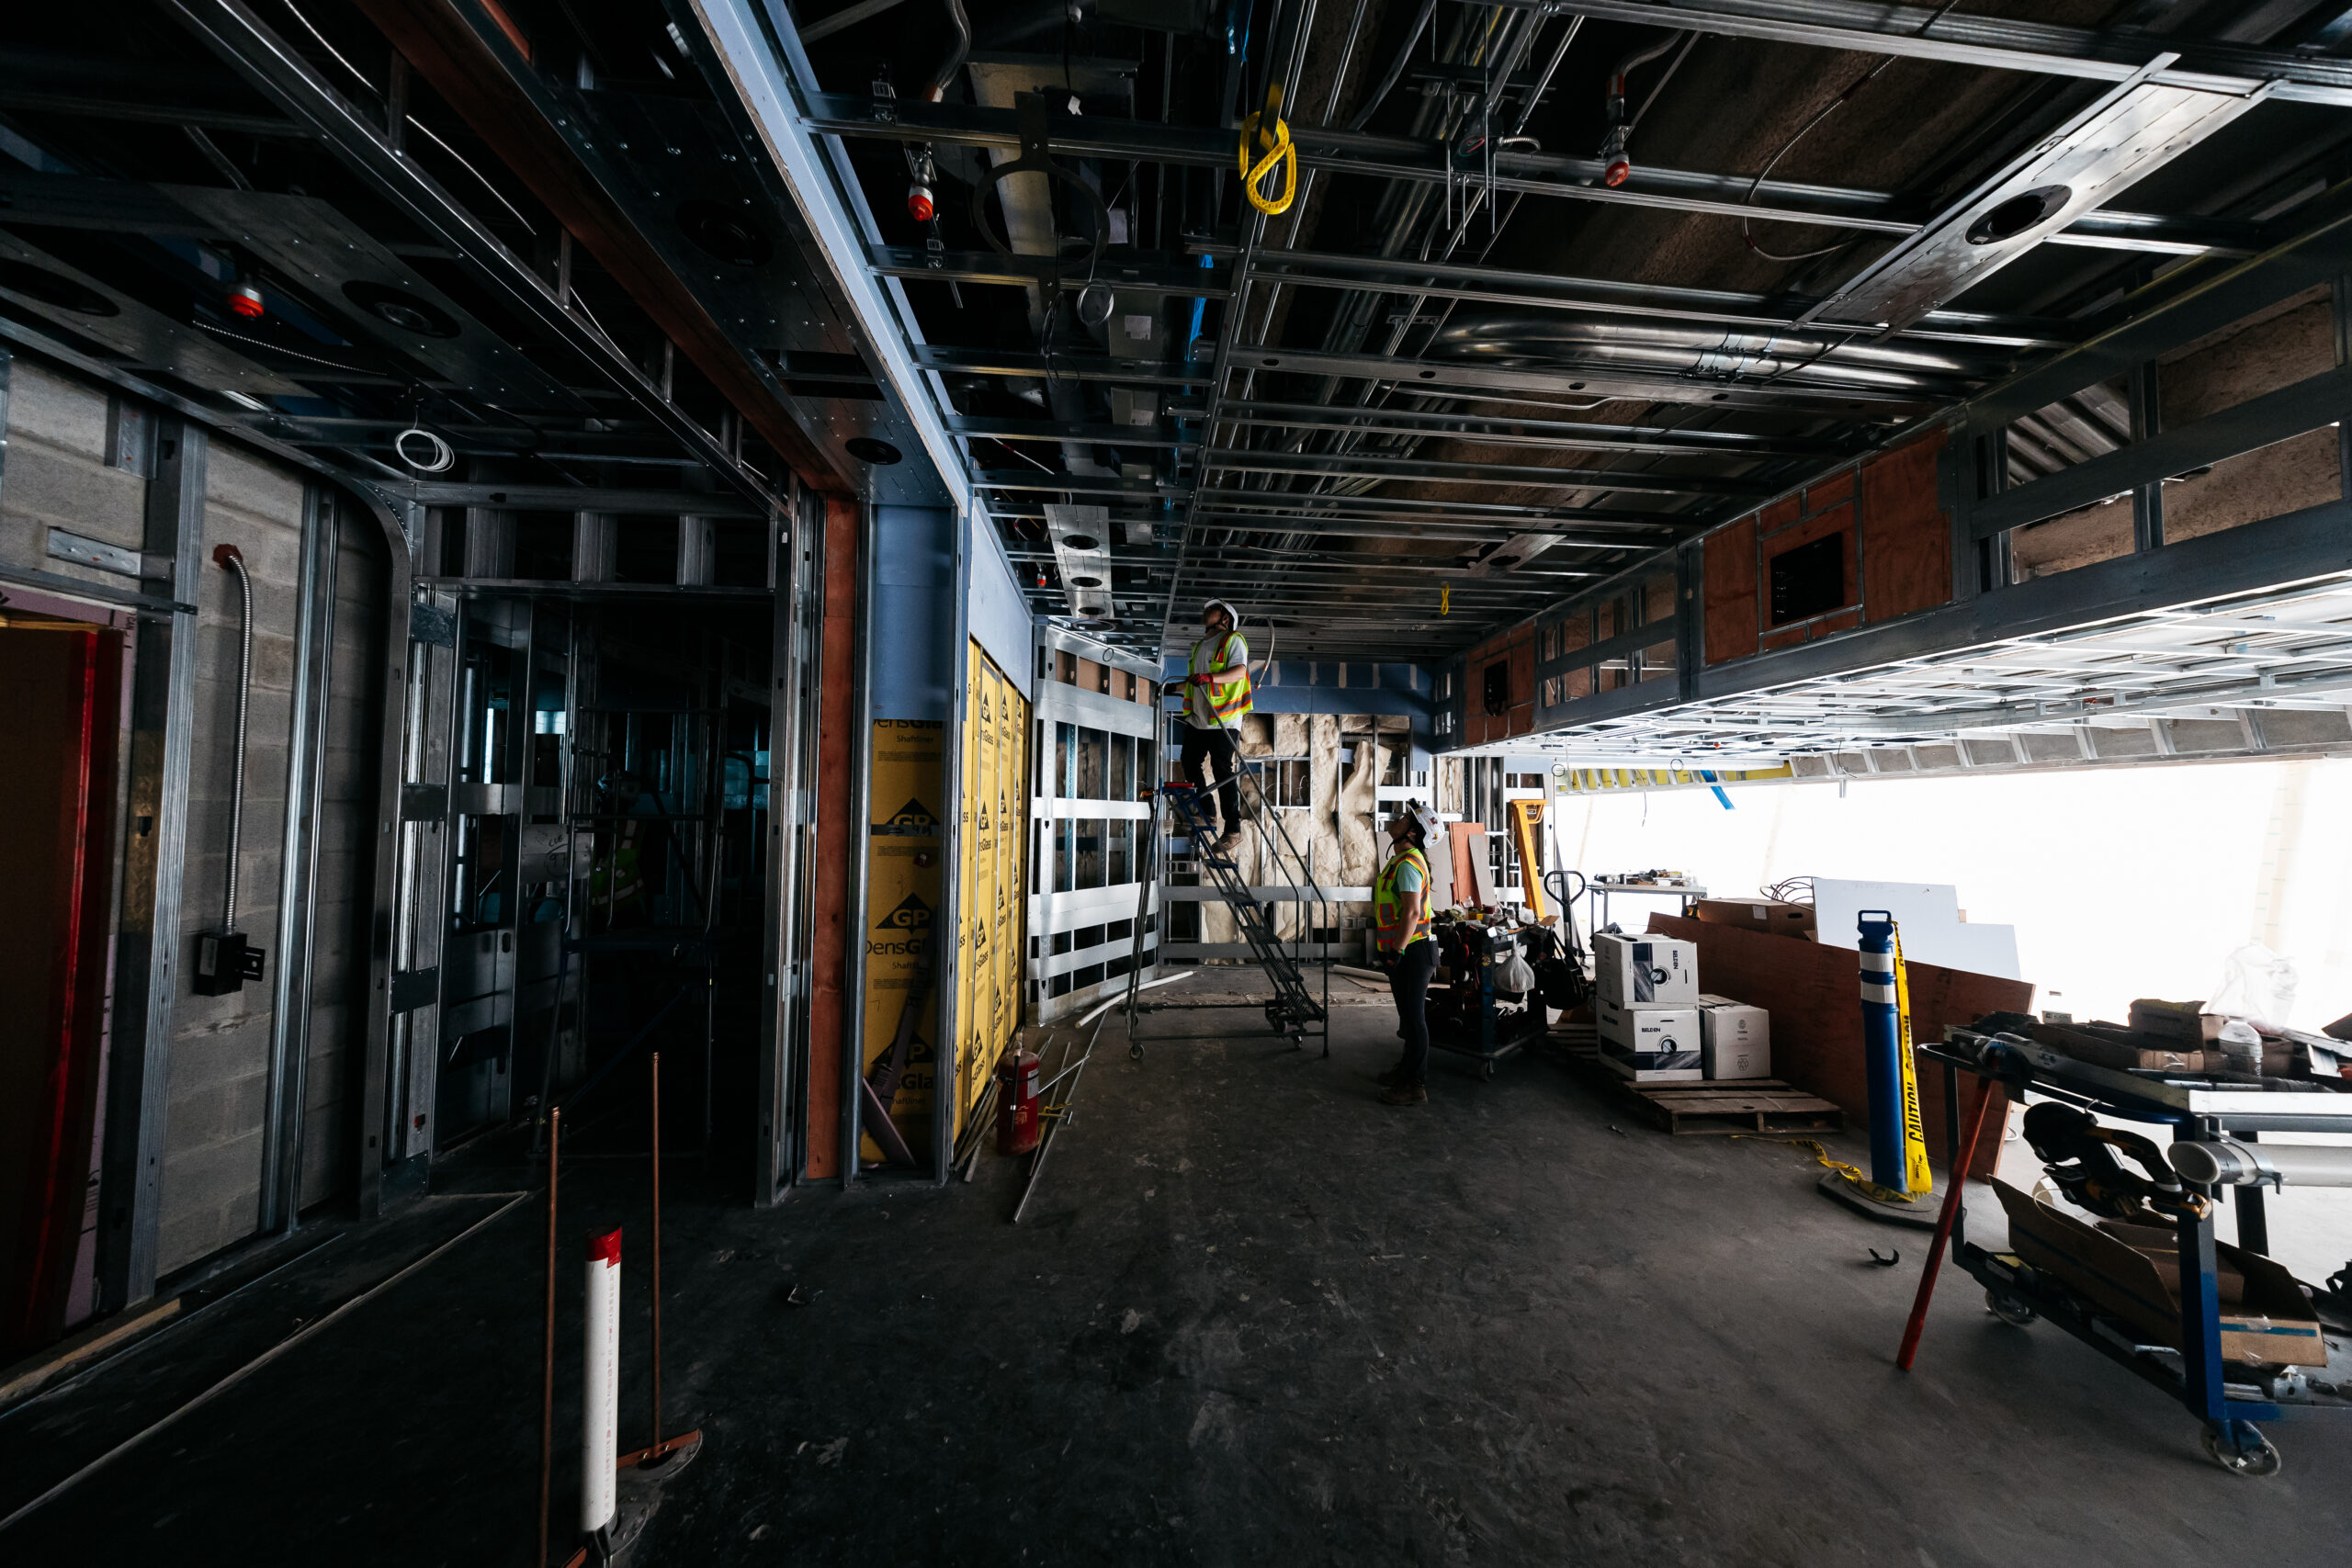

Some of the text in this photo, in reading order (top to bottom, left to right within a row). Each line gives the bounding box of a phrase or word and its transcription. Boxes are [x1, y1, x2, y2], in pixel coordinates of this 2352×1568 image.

[893, 814, 933, 825] GP
[892, 908, 931, 927] GP
[1907, 1082, 1924, 1143] CAUTION
